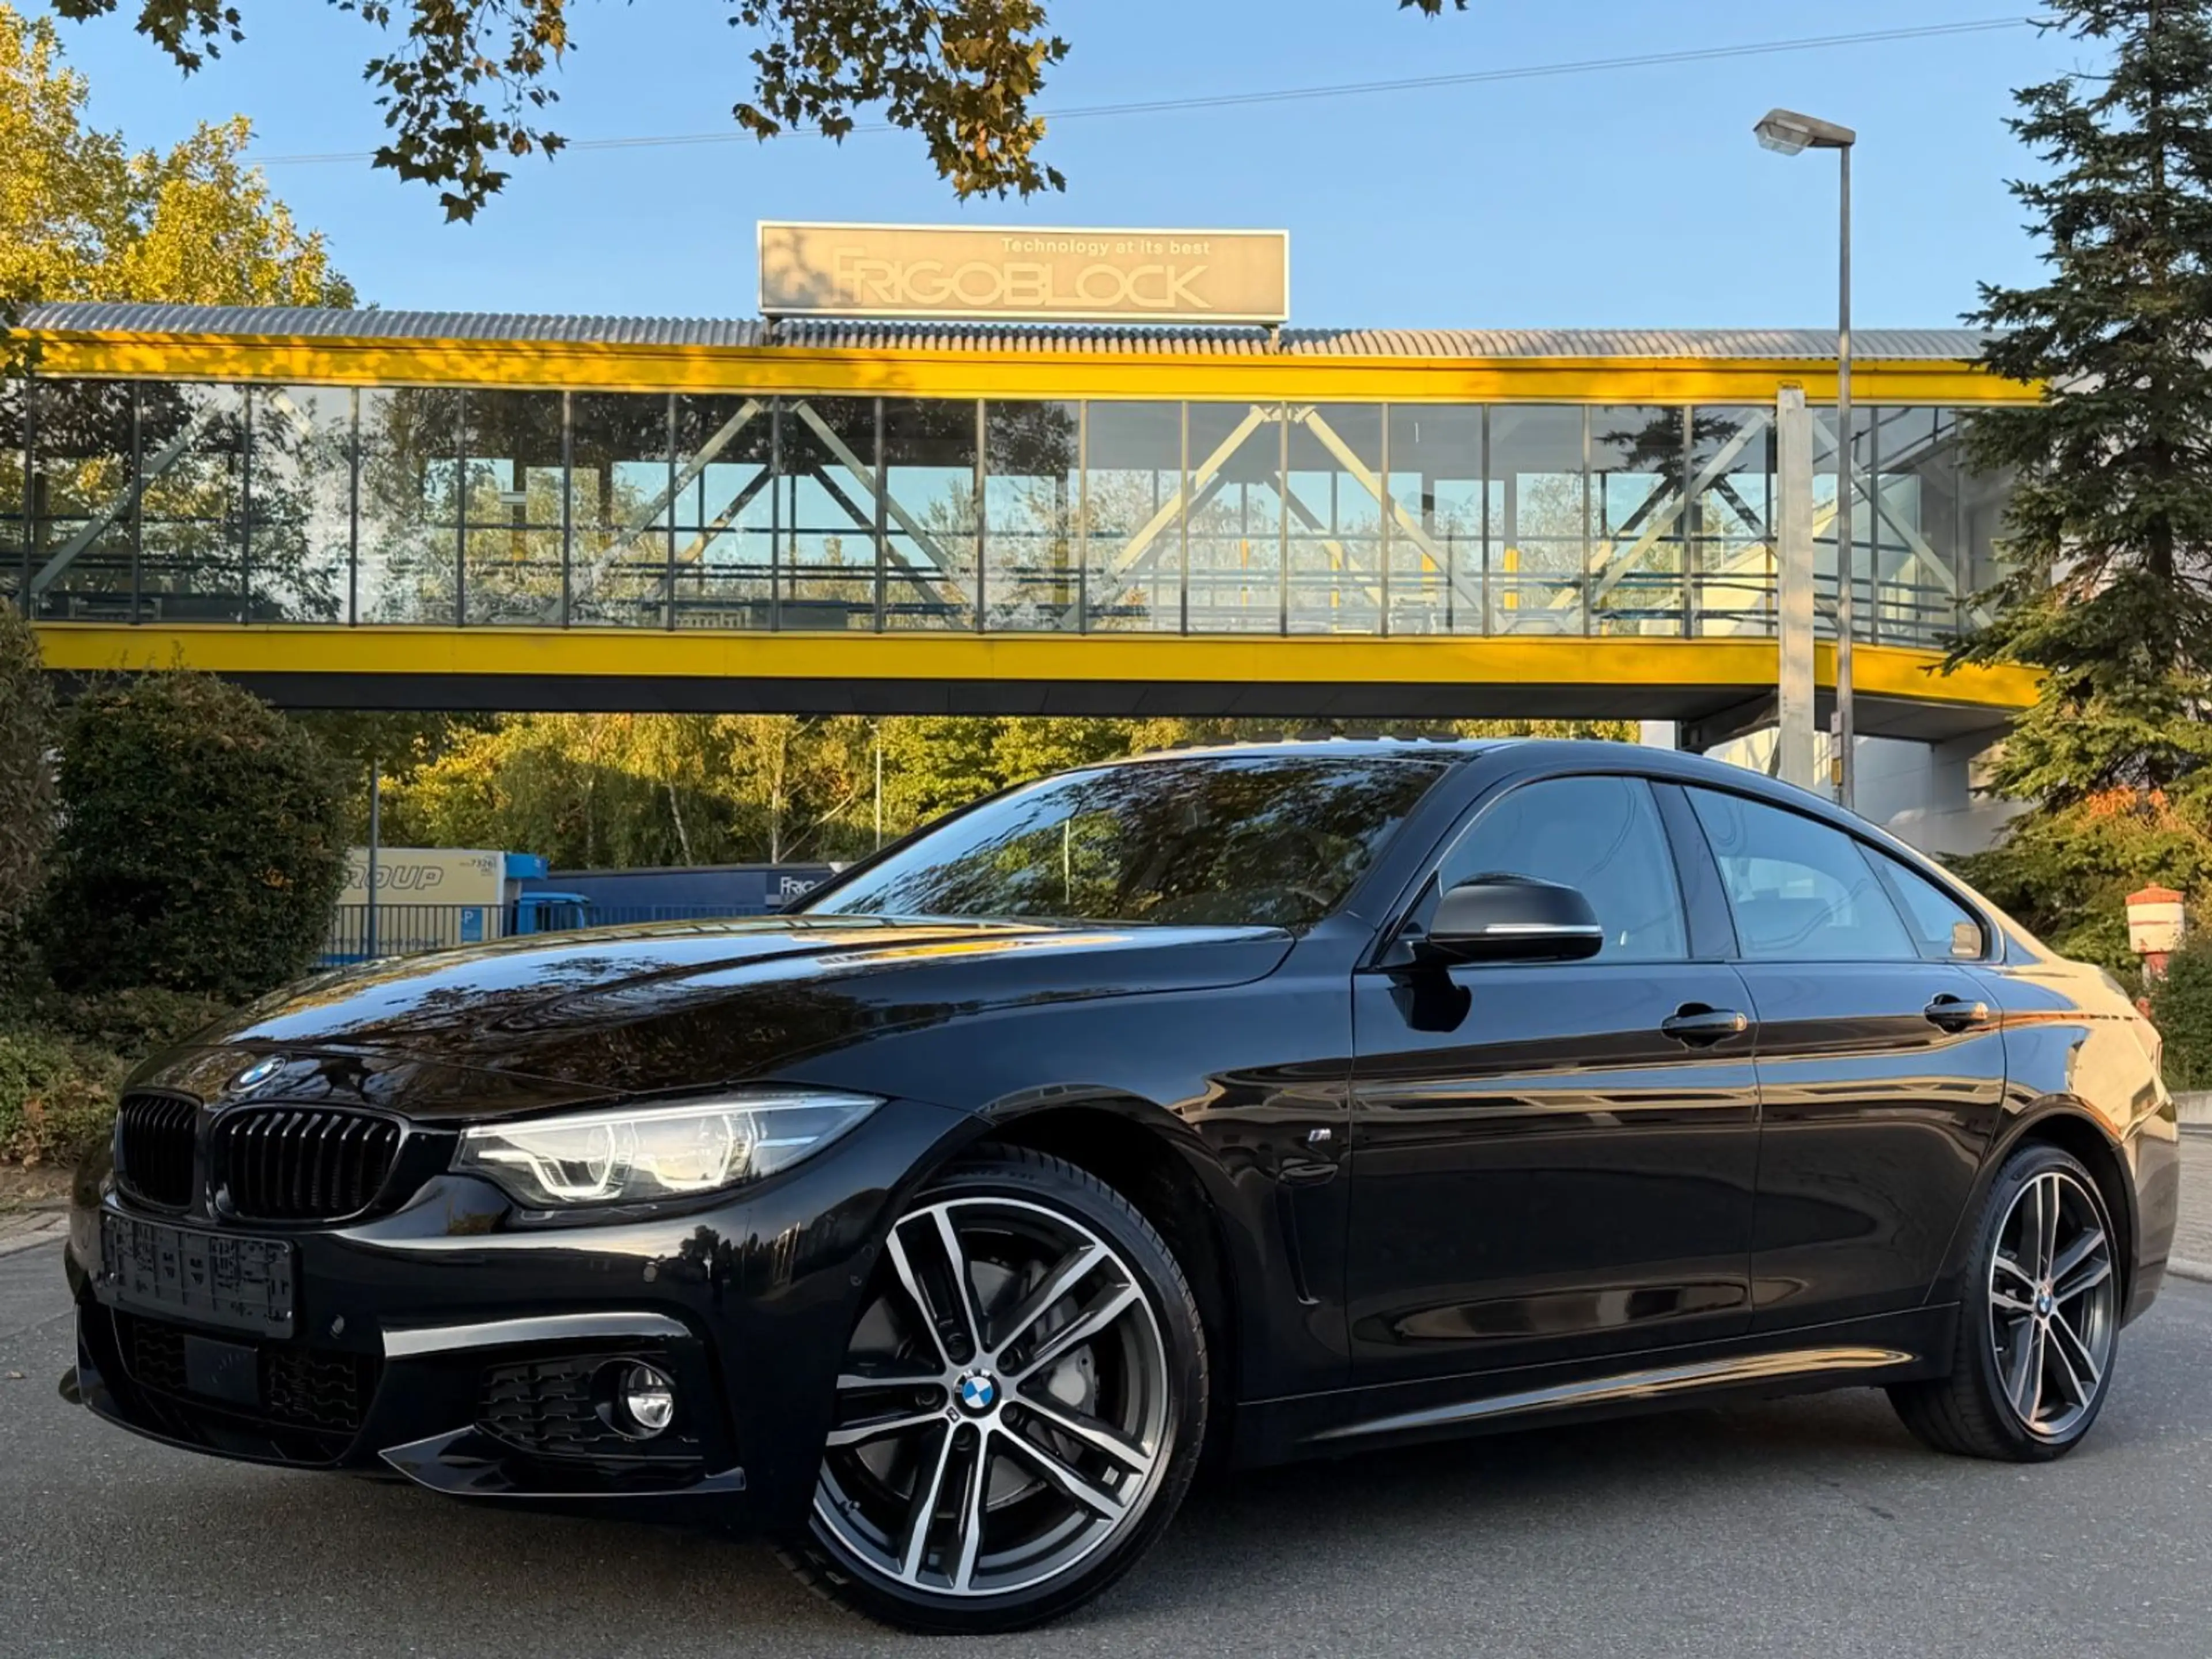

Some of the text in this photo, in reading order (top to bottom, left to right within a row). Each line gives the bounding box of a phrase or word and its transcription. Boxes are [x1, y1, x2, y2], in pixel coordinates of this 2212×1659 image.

[1002, 237, 1210, 256] Technology at its best
[833, 245, 1214, 308] FRIGOBLOCK
